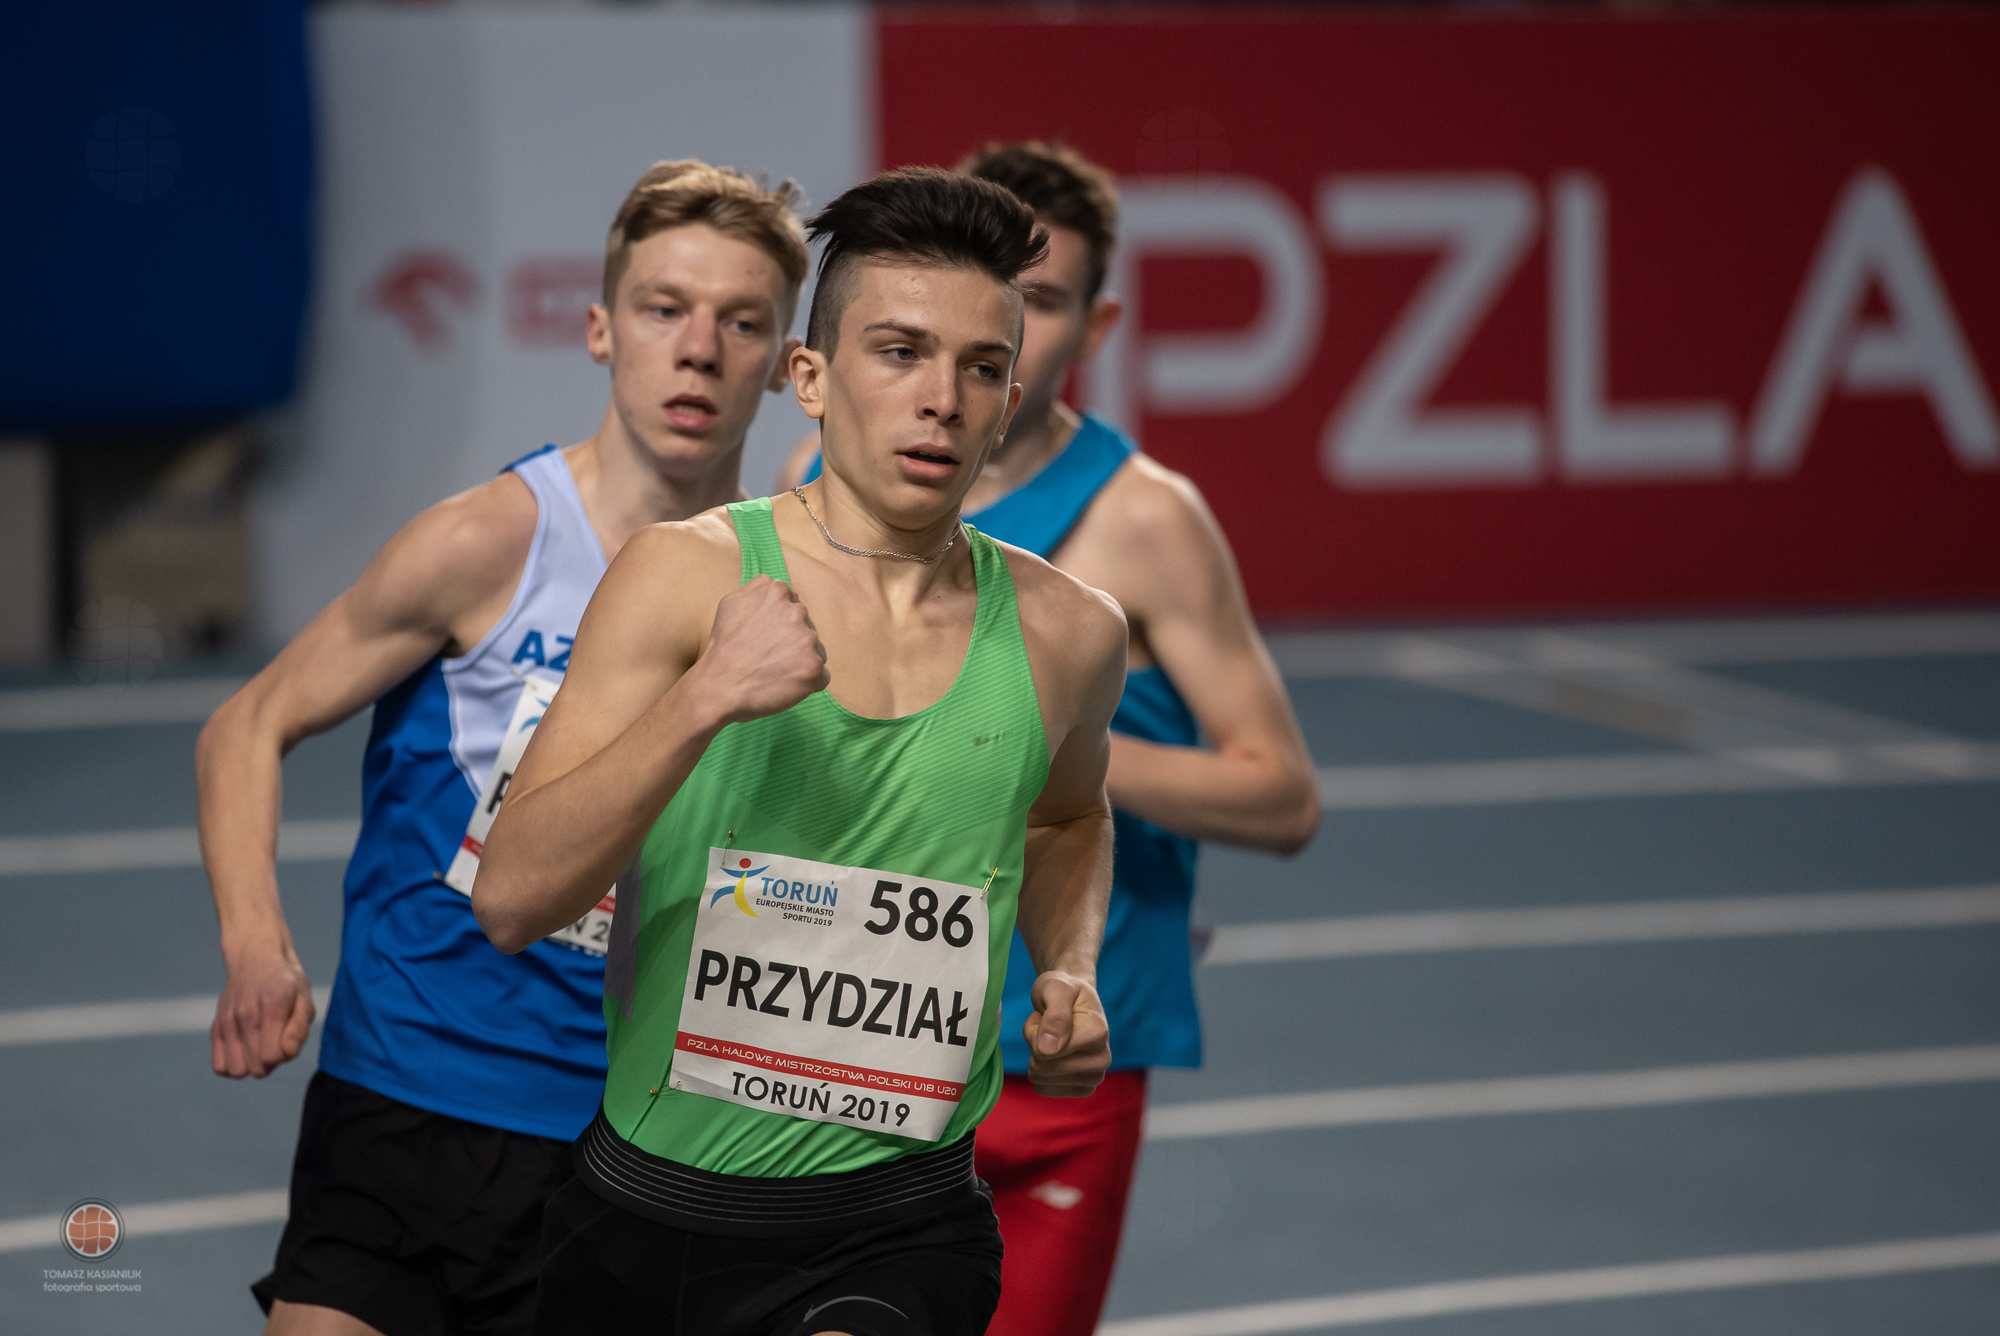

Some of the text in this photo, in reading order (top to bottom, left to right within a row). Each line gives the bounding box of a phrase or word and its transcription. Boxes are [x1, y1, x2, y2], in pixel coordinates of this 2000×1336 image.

[1083, 164, 2000, 490] PZLA
[756, 898, 834, 917] EUROPEJSKIE MIASTO
[761, 876, 838, 908] TORUŃ
[783, 912, 832, 927] SPORTU 2019
[863, 879, 974, 948] 586
[693, 948, 969, 1047] PRZYDZIAŁ
[687, 1038, 957, 1096] PZLA HALOWE MISTRZOSTWA POLSKI U18 U20
[732, 1071, 911, 1128] TORUŃ 2019
